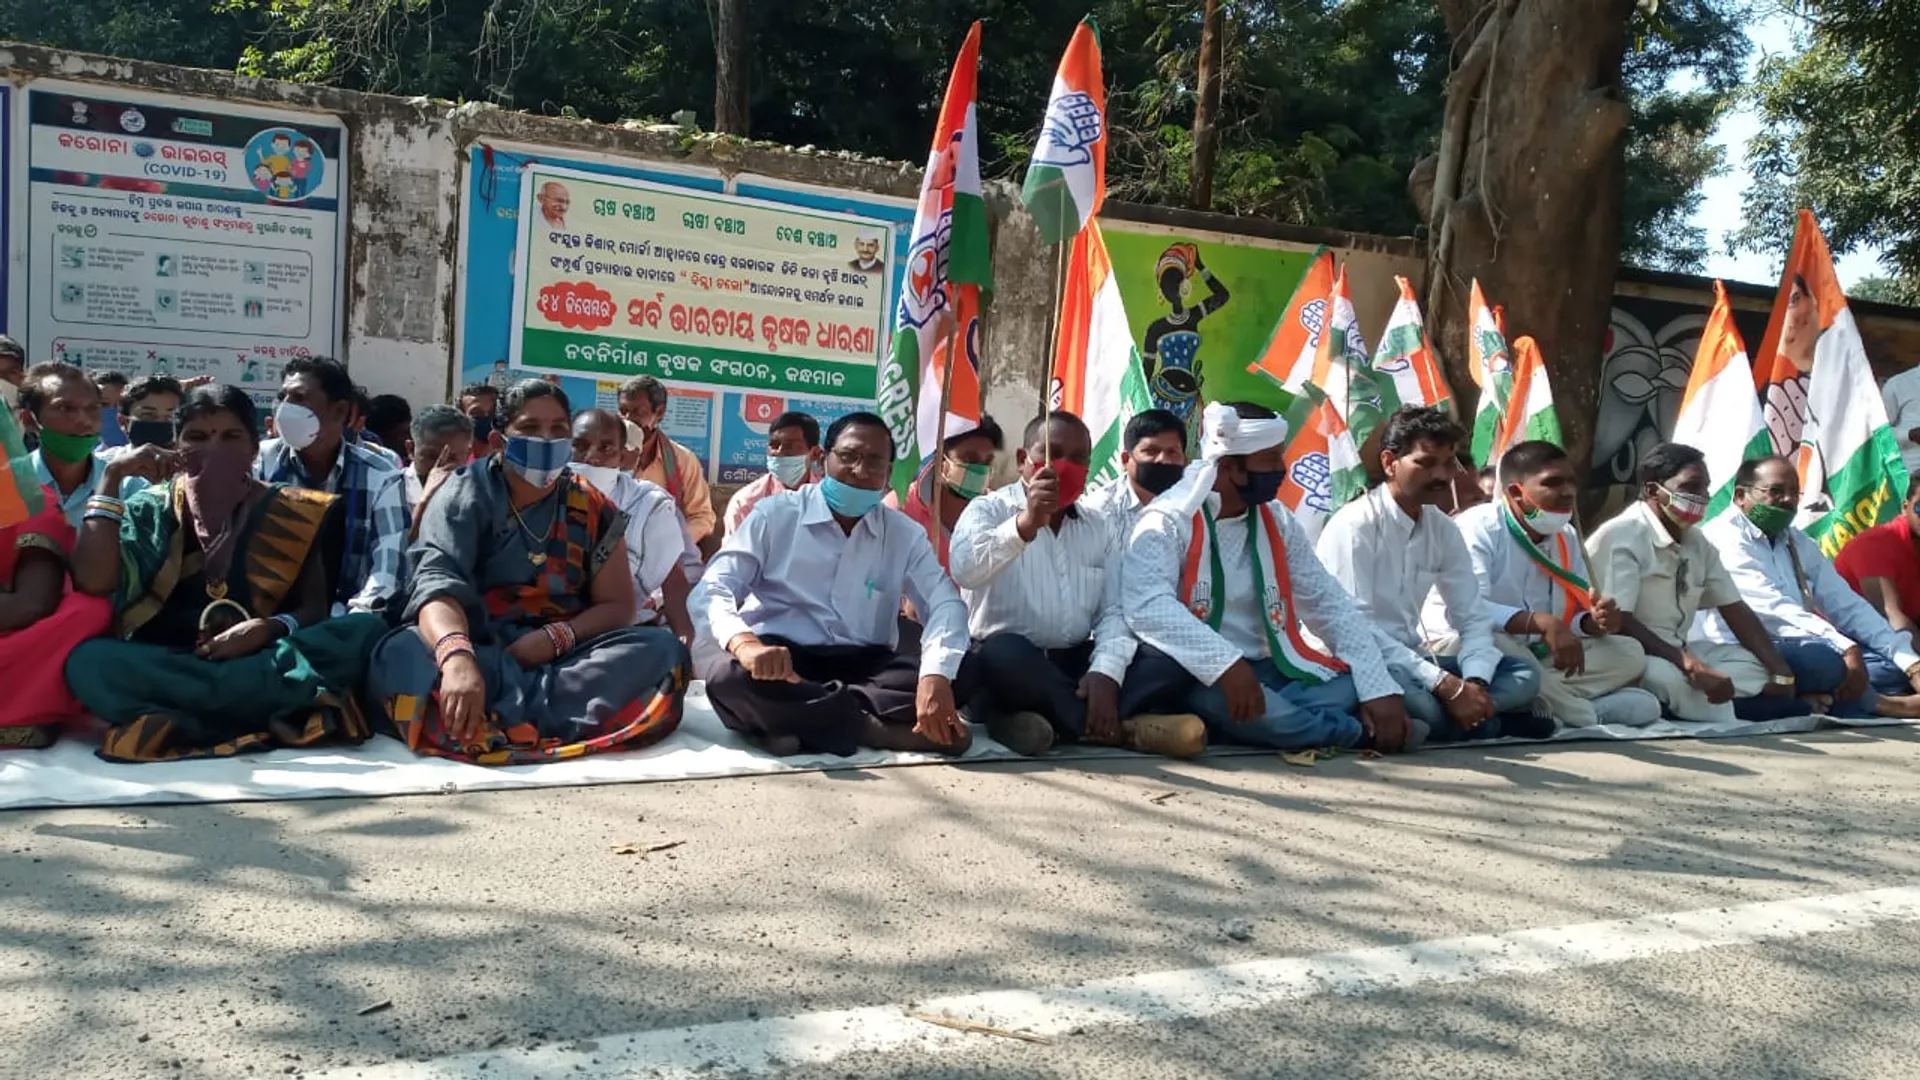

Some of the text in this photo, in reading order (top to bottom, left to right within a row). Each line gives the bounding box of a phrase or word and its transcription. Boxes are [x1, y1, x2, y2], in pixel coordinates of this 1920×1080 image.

[58, 133, 228, 168] କରୋନା ଭାଇରସ୍
[144, 163, 227, 182] (COVID-19)
[776, 226, 802, 244] ଦେଶ
[669, 303, 754, 342] ଭାରତୀୟ
[761, 314, 811, 352] କୃଷକ
[816, 321, 874, 353] ଧାରଣା
[565, 341, 648, 367] ନବନିର୍ମାଣ
[656, 353, 702, 377] କୃଷକ
[709, 358, 777, 383] ସଂଗଠନ,
[880, 344, 915, 460] GRESS
